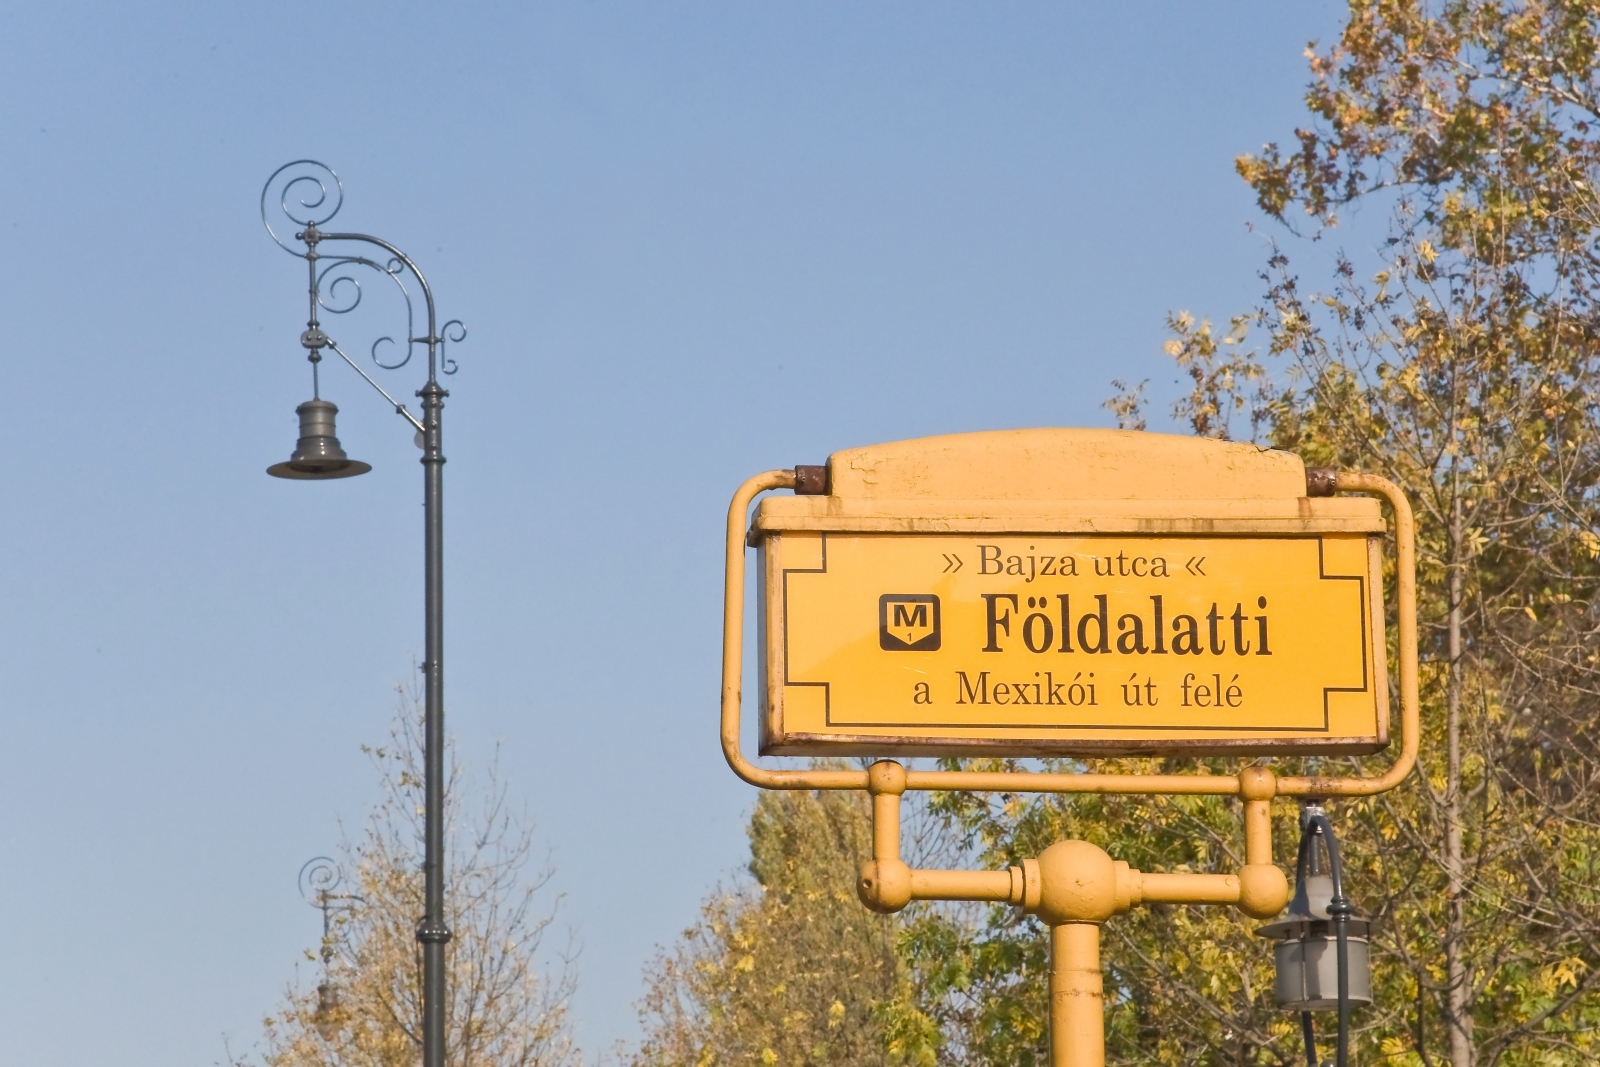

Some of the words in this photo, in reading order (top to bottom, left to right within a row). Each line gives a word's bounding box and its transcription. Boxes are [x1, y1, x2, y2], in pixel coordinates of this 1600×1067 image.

[977, 545, 1080, 583] Bajza
[1094, 549, 1171, 578] utca
[893, 604, 928, 628] M
[980, 593, 1273, 657] Földalatti
[906, 632, 912, 642] 1
[913, 682, 933, 705] a
[955, 671, 1099, 706] Mexikói
[1120, 672, 1158, 707] út
[1180, 672, 1243, 708] felé
